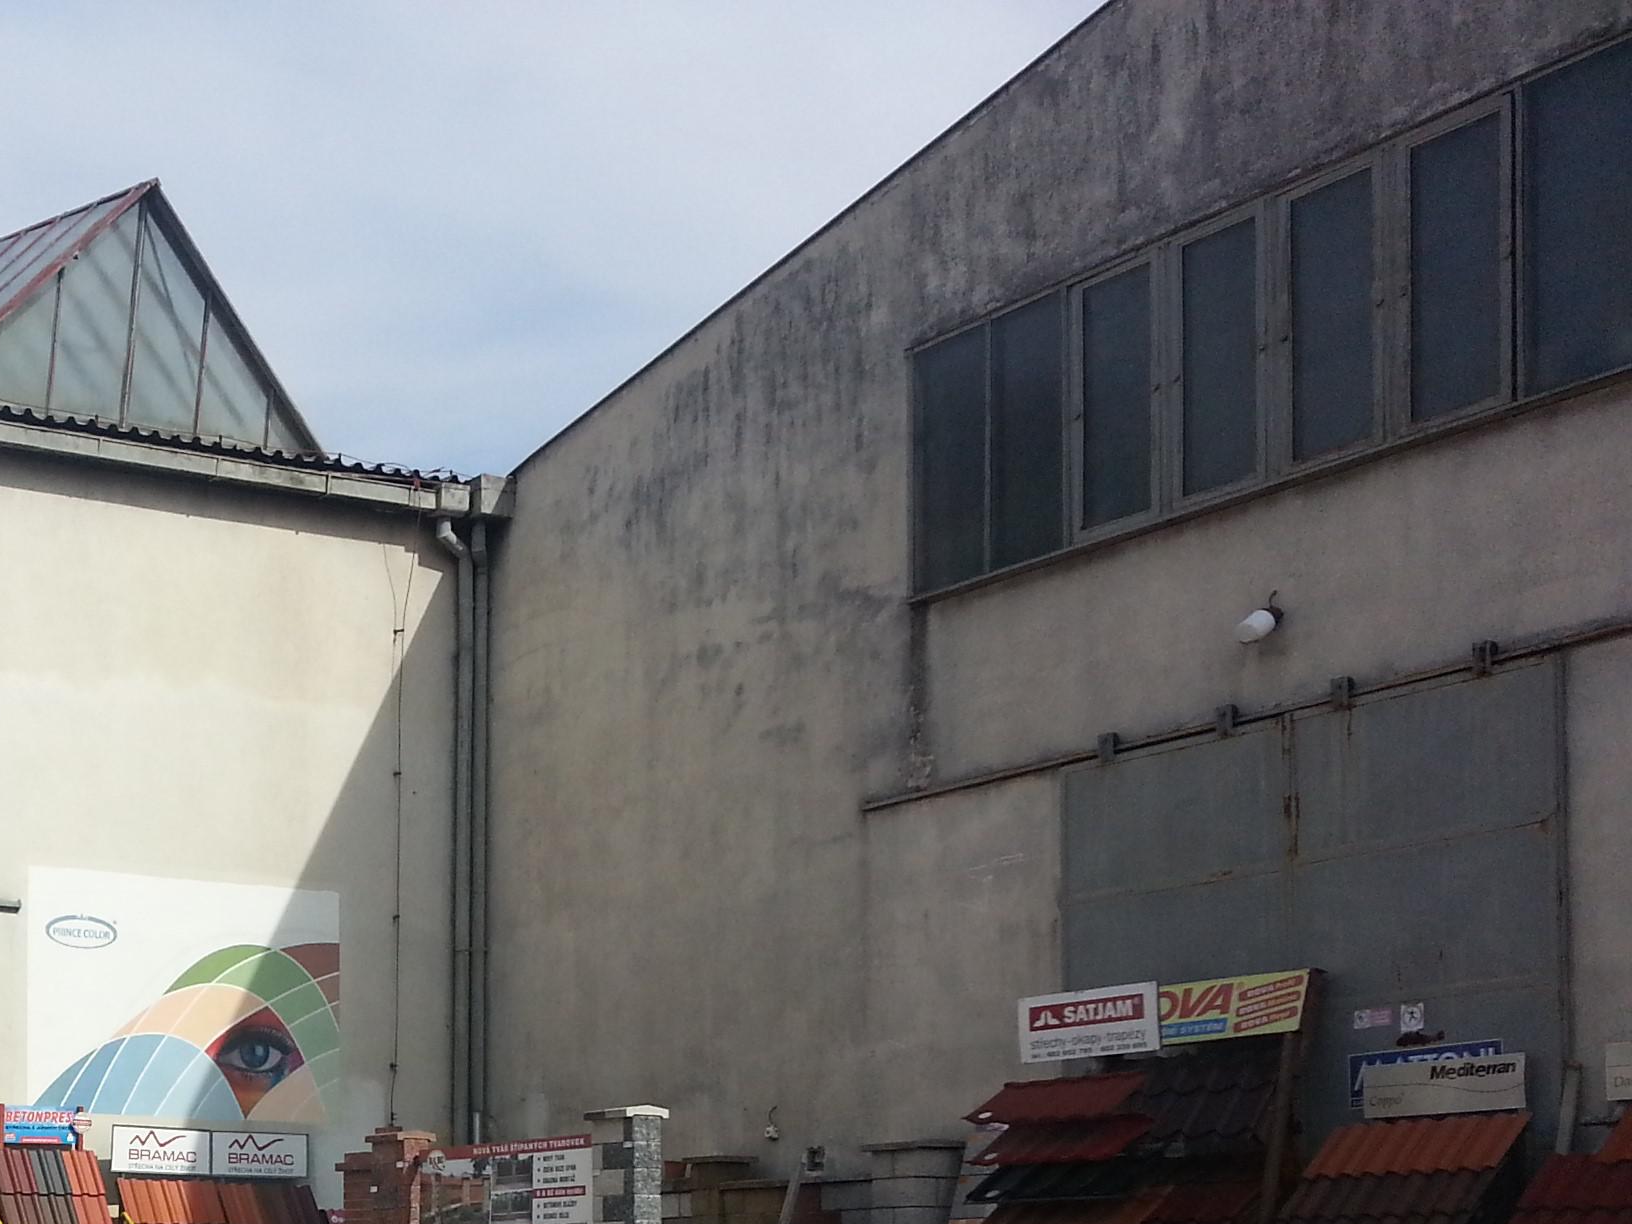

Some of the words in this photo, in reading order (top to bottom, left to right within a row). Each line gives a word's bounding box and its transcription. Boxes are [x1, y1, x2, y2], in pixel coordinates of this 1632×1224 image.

[1063, 999, 1134, 1024] SATJAM
[1430, 1061, 1517, 1081] Mediterran
[128, 1148, 197, 1164] BRAMAC
[228, 1152, 295, 1166] BRAMAC
